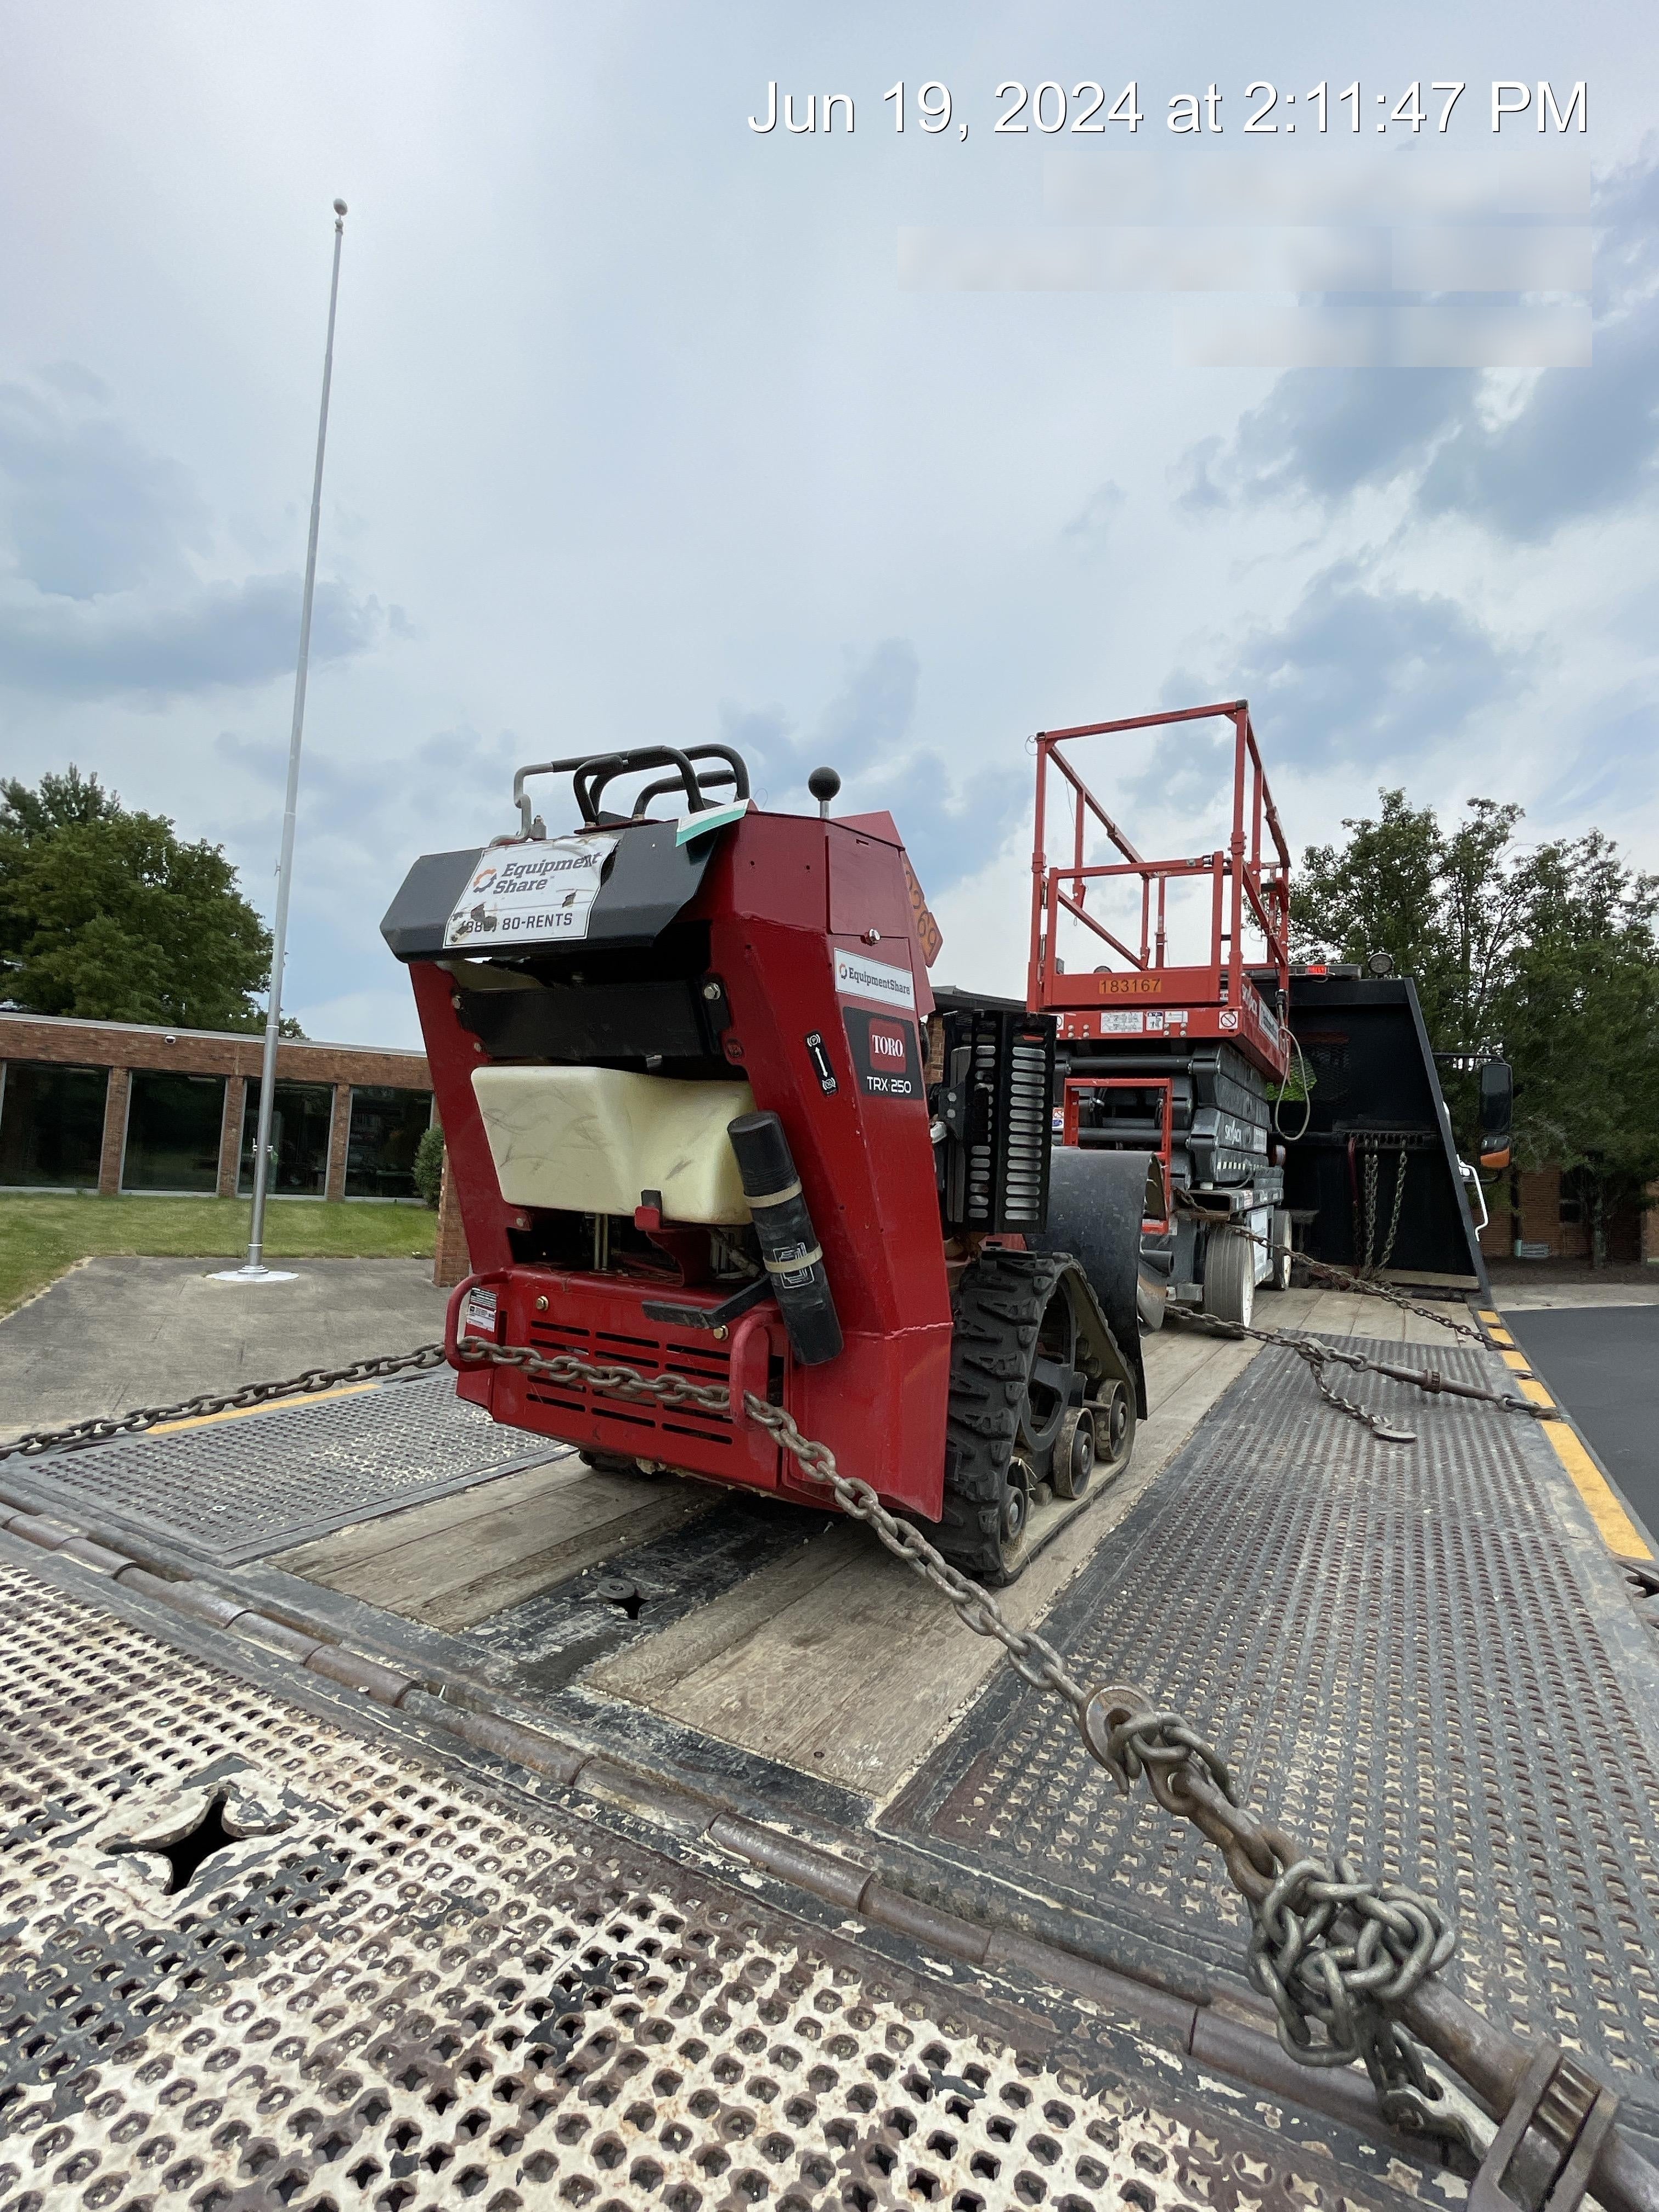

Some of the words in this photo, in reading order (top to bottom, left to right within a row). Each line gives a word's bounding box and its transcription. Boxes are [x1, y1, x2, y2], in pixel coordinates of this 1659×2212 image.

[501, 852, 602, 879] Equipment
[493, 878, 548, 895] Share
[502, 912, 573, 931] 80-RENTS
[848, 966, 911, 995] EquipmentShare
[1101, 978, 1161, 993] 183167
[871, 1034, 904, 1057] TORO
[866, 1076, 889, 1092] TRX
[890, 1079, 912, 1094] 250
